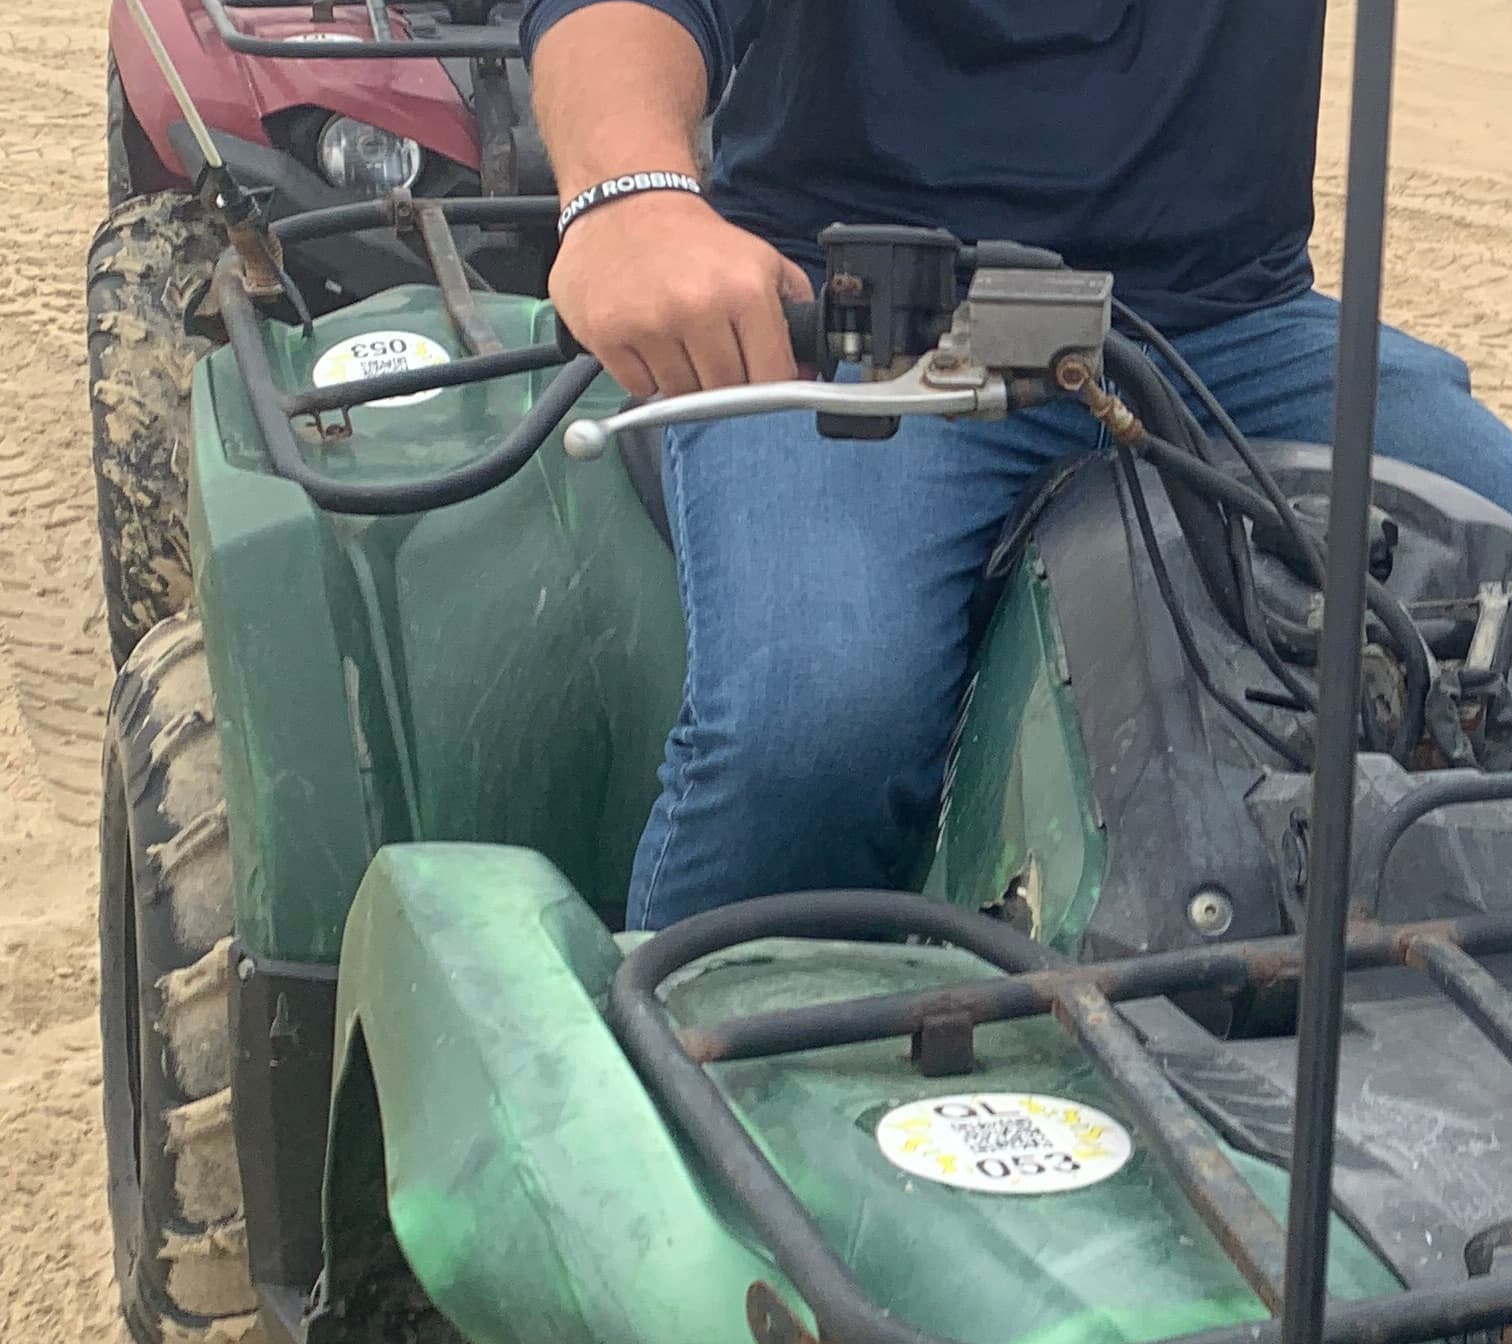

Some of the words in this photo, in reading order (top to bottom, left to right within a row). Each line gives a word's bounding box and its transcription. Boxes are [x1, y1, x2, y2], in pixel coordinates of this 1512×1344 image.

[601, 172, 700, 198] ROBBINS
[350, 338, 408, 359] 053
[975, 1153, 1081, 1179] 053
